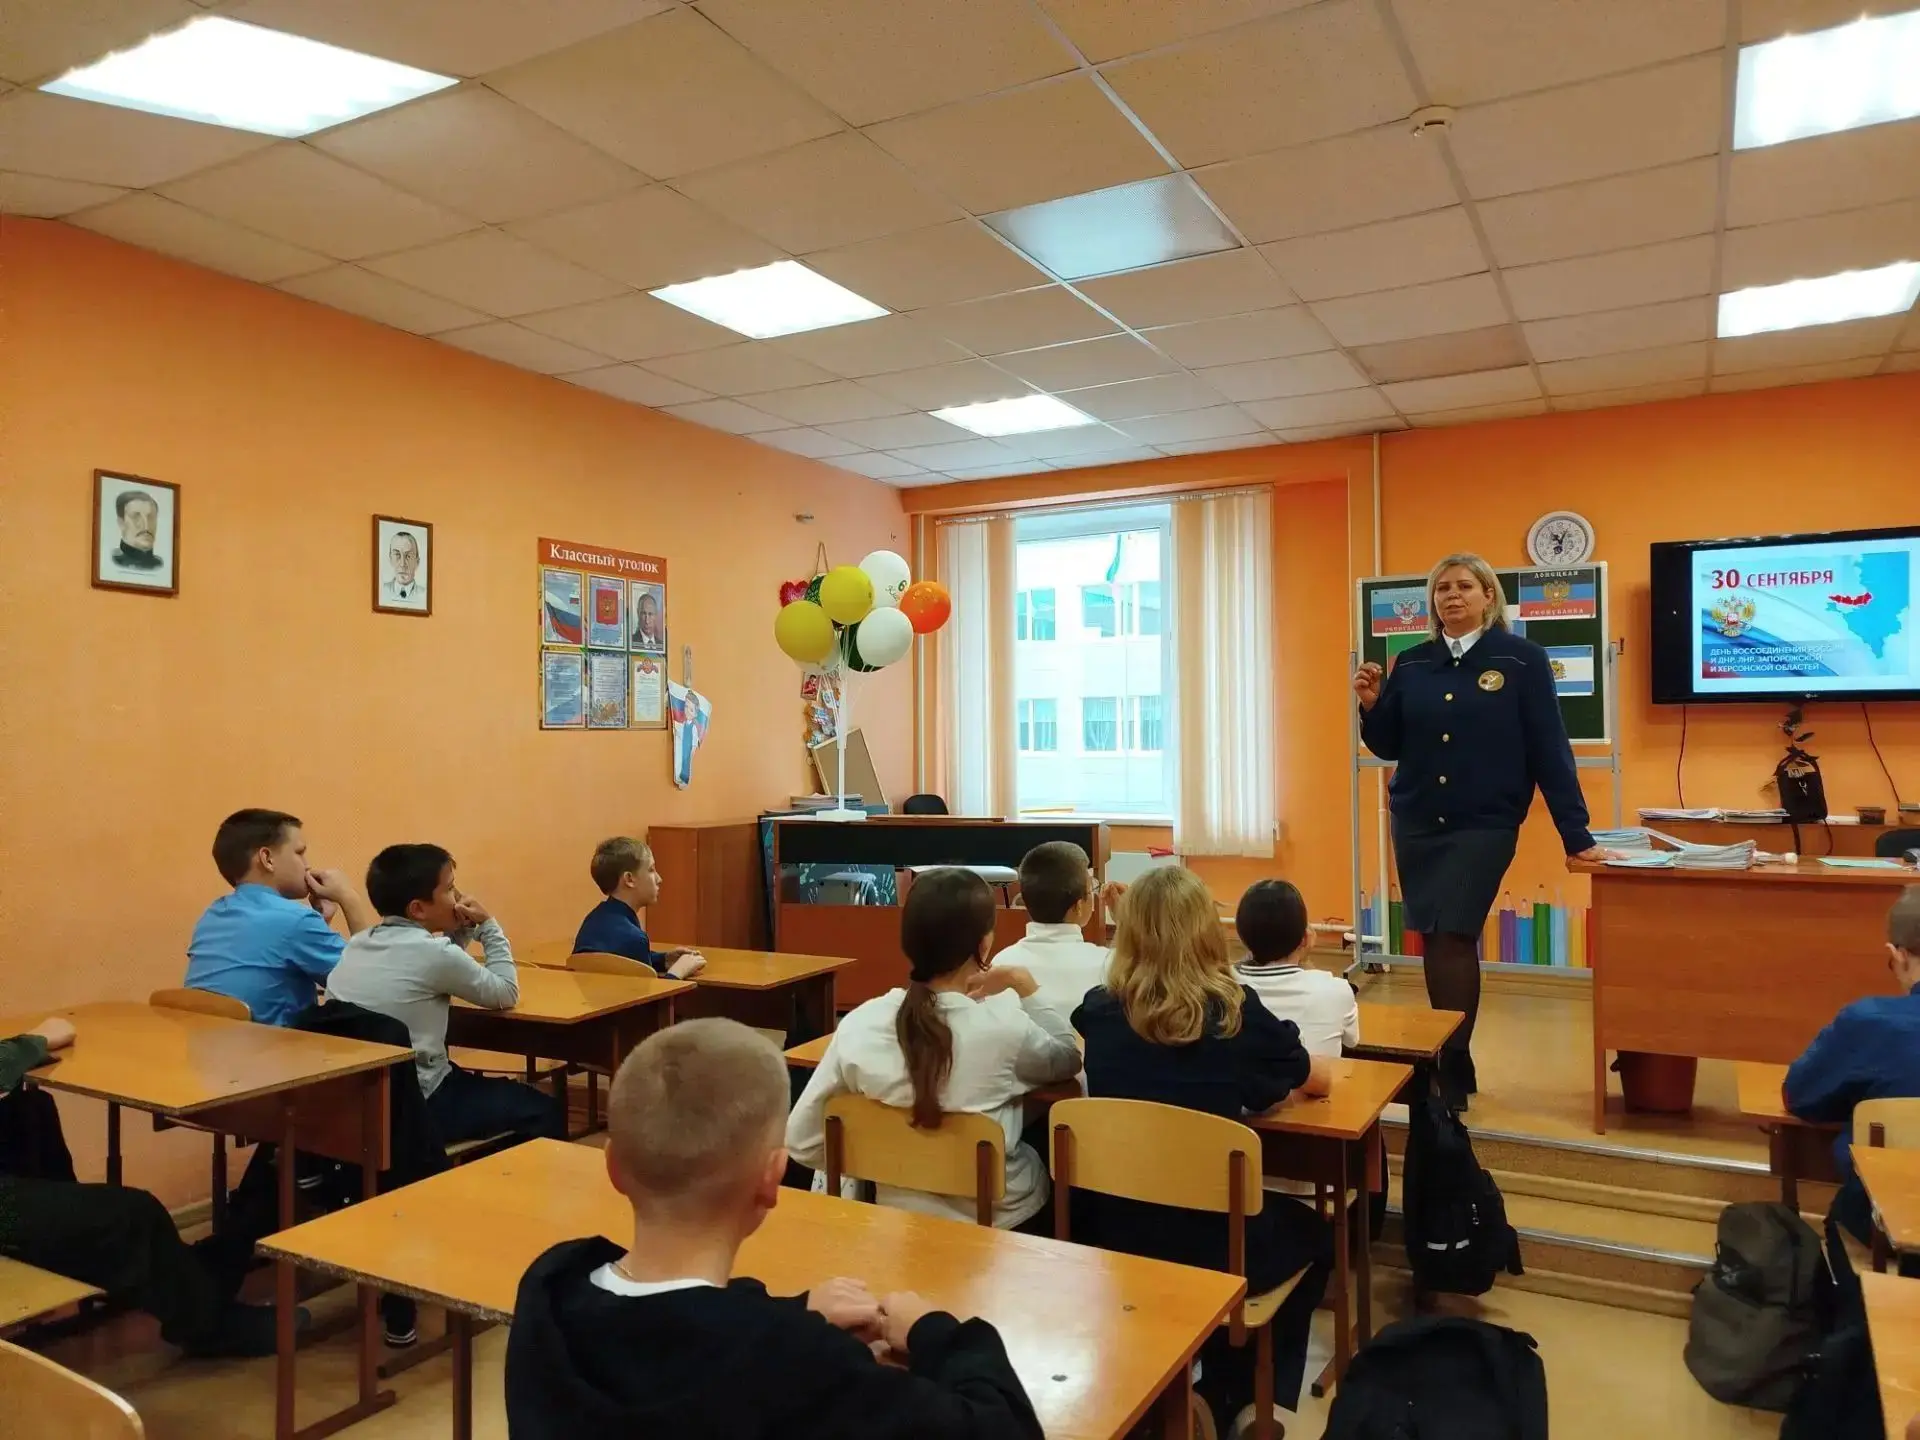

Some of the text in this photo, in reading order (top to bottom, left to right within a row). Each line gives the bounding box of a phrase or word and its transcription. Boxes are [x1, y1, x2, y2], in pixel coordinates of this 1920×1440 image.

[550, 543, 659, 573] Классный уголок
[1711, 569, 1833, 589] 30 СЕНТЯБРЯ
[1710, 648, 1731, 656] ДЕНЬ
[1732, 646, 1806, 655] ВОССОЕДИНЕНИЯ
[1710, 656, 1717, 664] И
[1758, 653, 1823, 663] ЗАПОРОЖСКОЙ
[1710, 662, 1820, 673] И ХЕРСОНСКОЙ ОБЛАСТЕЙ
